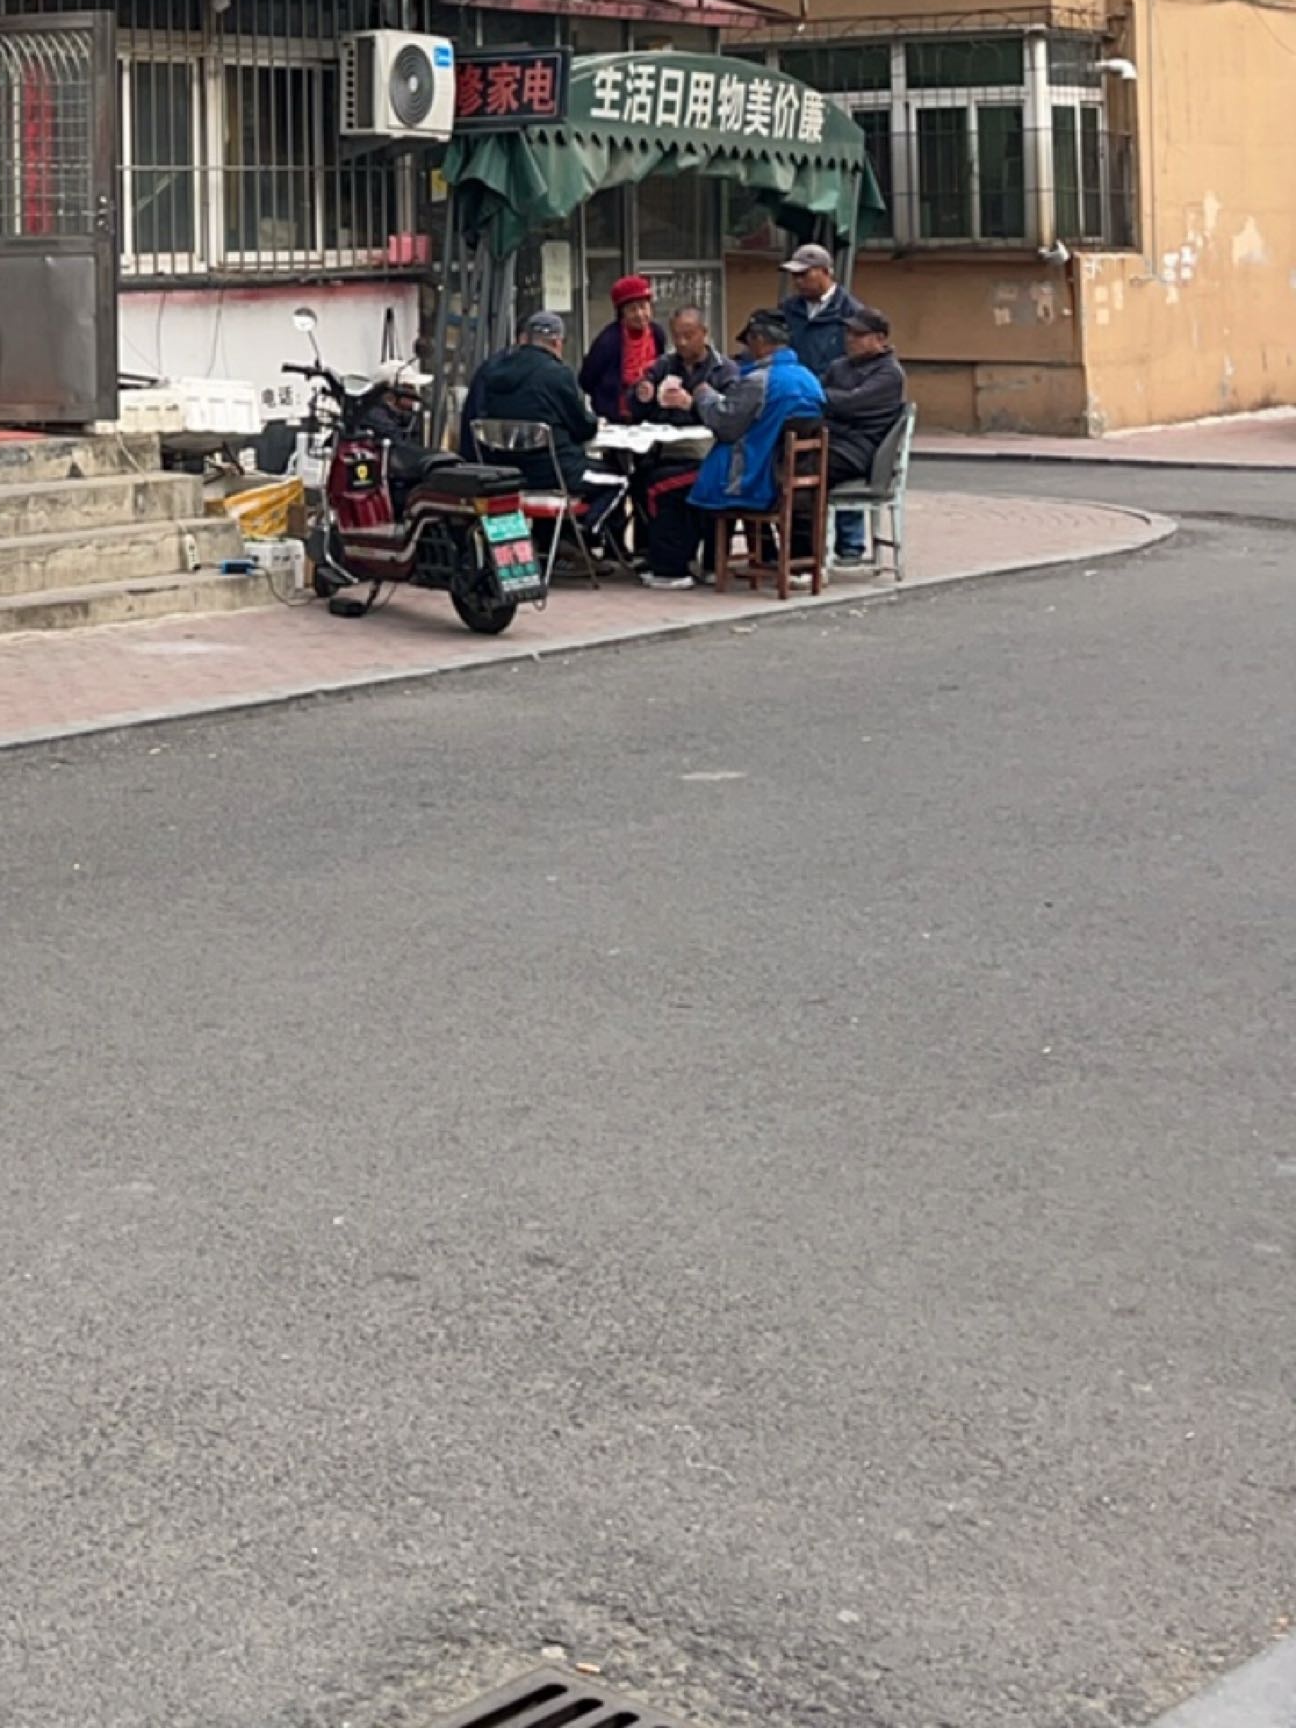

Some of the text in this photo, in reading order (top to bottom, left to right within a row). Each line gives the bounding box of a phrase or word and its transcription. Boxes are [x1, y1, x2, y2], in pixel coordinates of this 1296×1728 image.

[590, 62, 825, 143] 生活日用物美价廉
